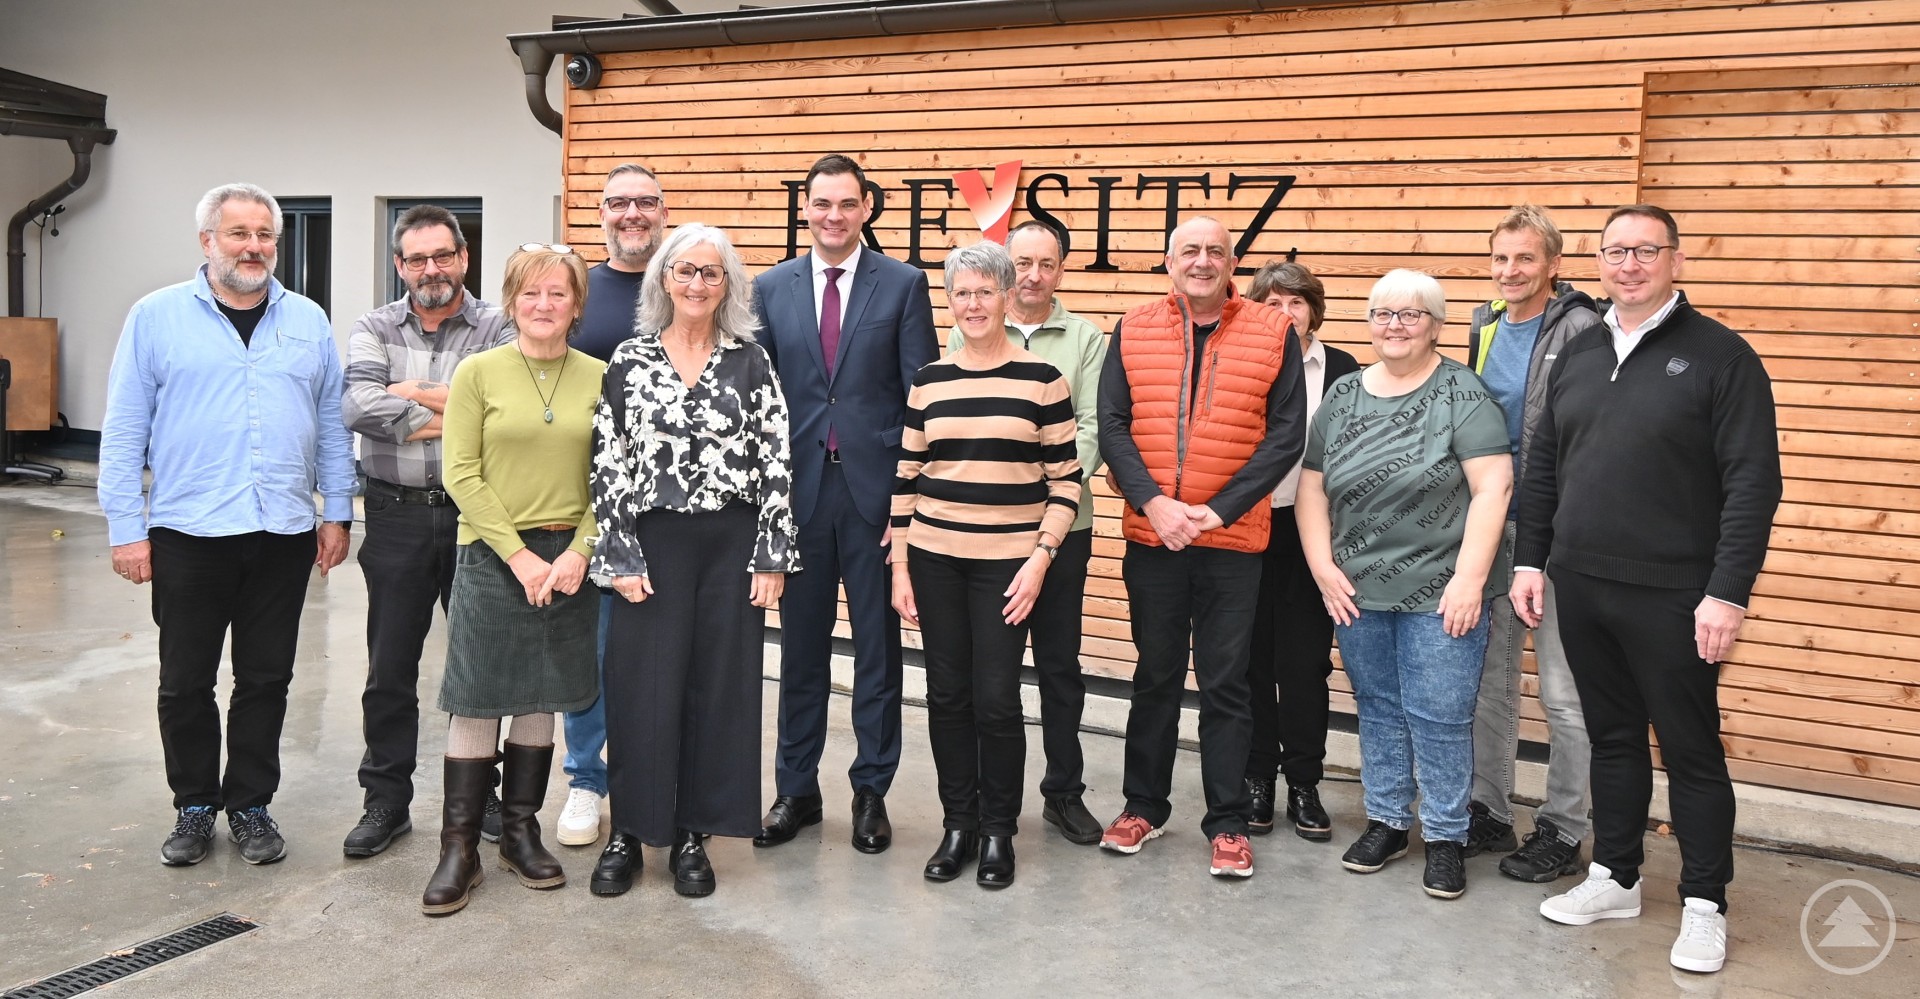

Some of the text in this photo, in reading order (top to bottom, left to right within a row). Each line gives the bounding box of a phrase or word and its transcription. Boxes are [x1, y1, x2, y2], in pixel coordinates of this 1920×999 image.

[1341, 452, 1414, 507] FREEDOM
[1372, 502, 1419, 537] FREEDOM
[1352, 557, 1386, 582] PERFECT
